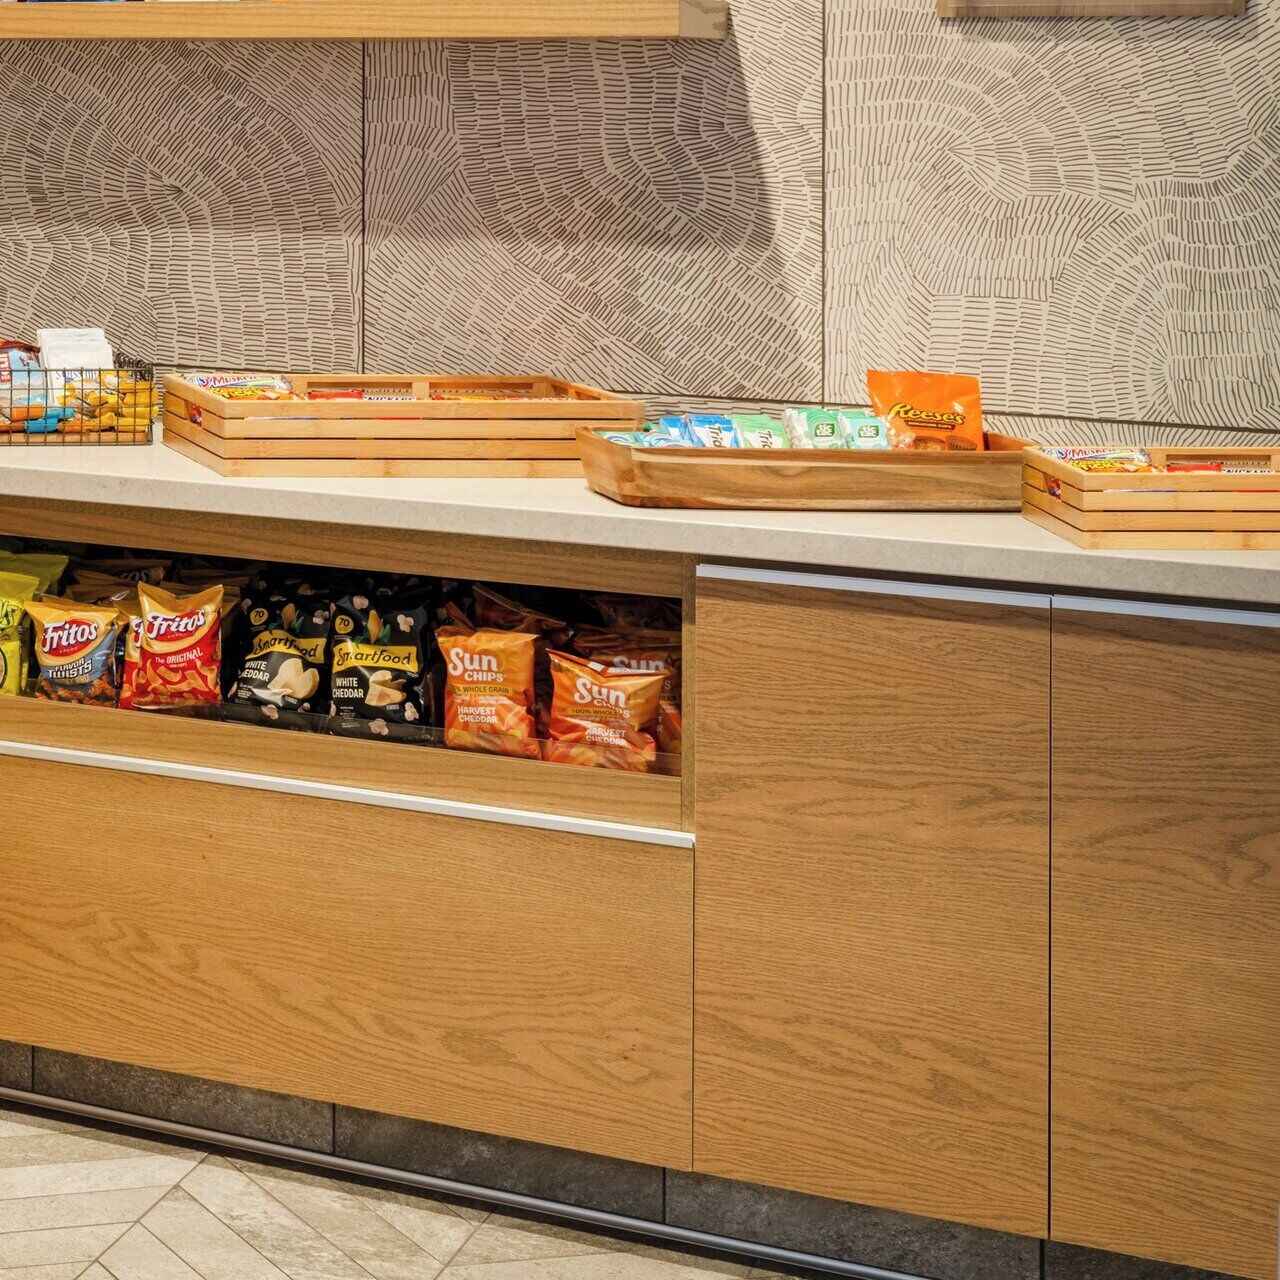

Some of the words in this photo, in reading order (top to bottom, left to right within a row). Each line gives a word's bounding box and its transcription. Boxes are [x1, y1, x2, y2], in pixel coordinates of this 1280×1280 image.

[889, 403, 964, 426] Reese's
[147, 609, 206, 640] Fritos
[42, 621, 98, 654] Fritos
[166, 647, 203, 663] ORIGINAL
[449, 646, 498, 674] Sun
[336, 677, 359, 688] WHITE
[464, 672, 504, 683] CHIPS
[333, 687, 364, 700] CHEDDAR
[462, 685, 486, 694] WHOLE
[488, 686, 509, 695] GRAIN
[457, 705, 496, 717] HARVEST
[459, 714, 497, 725] CHEDDAR
